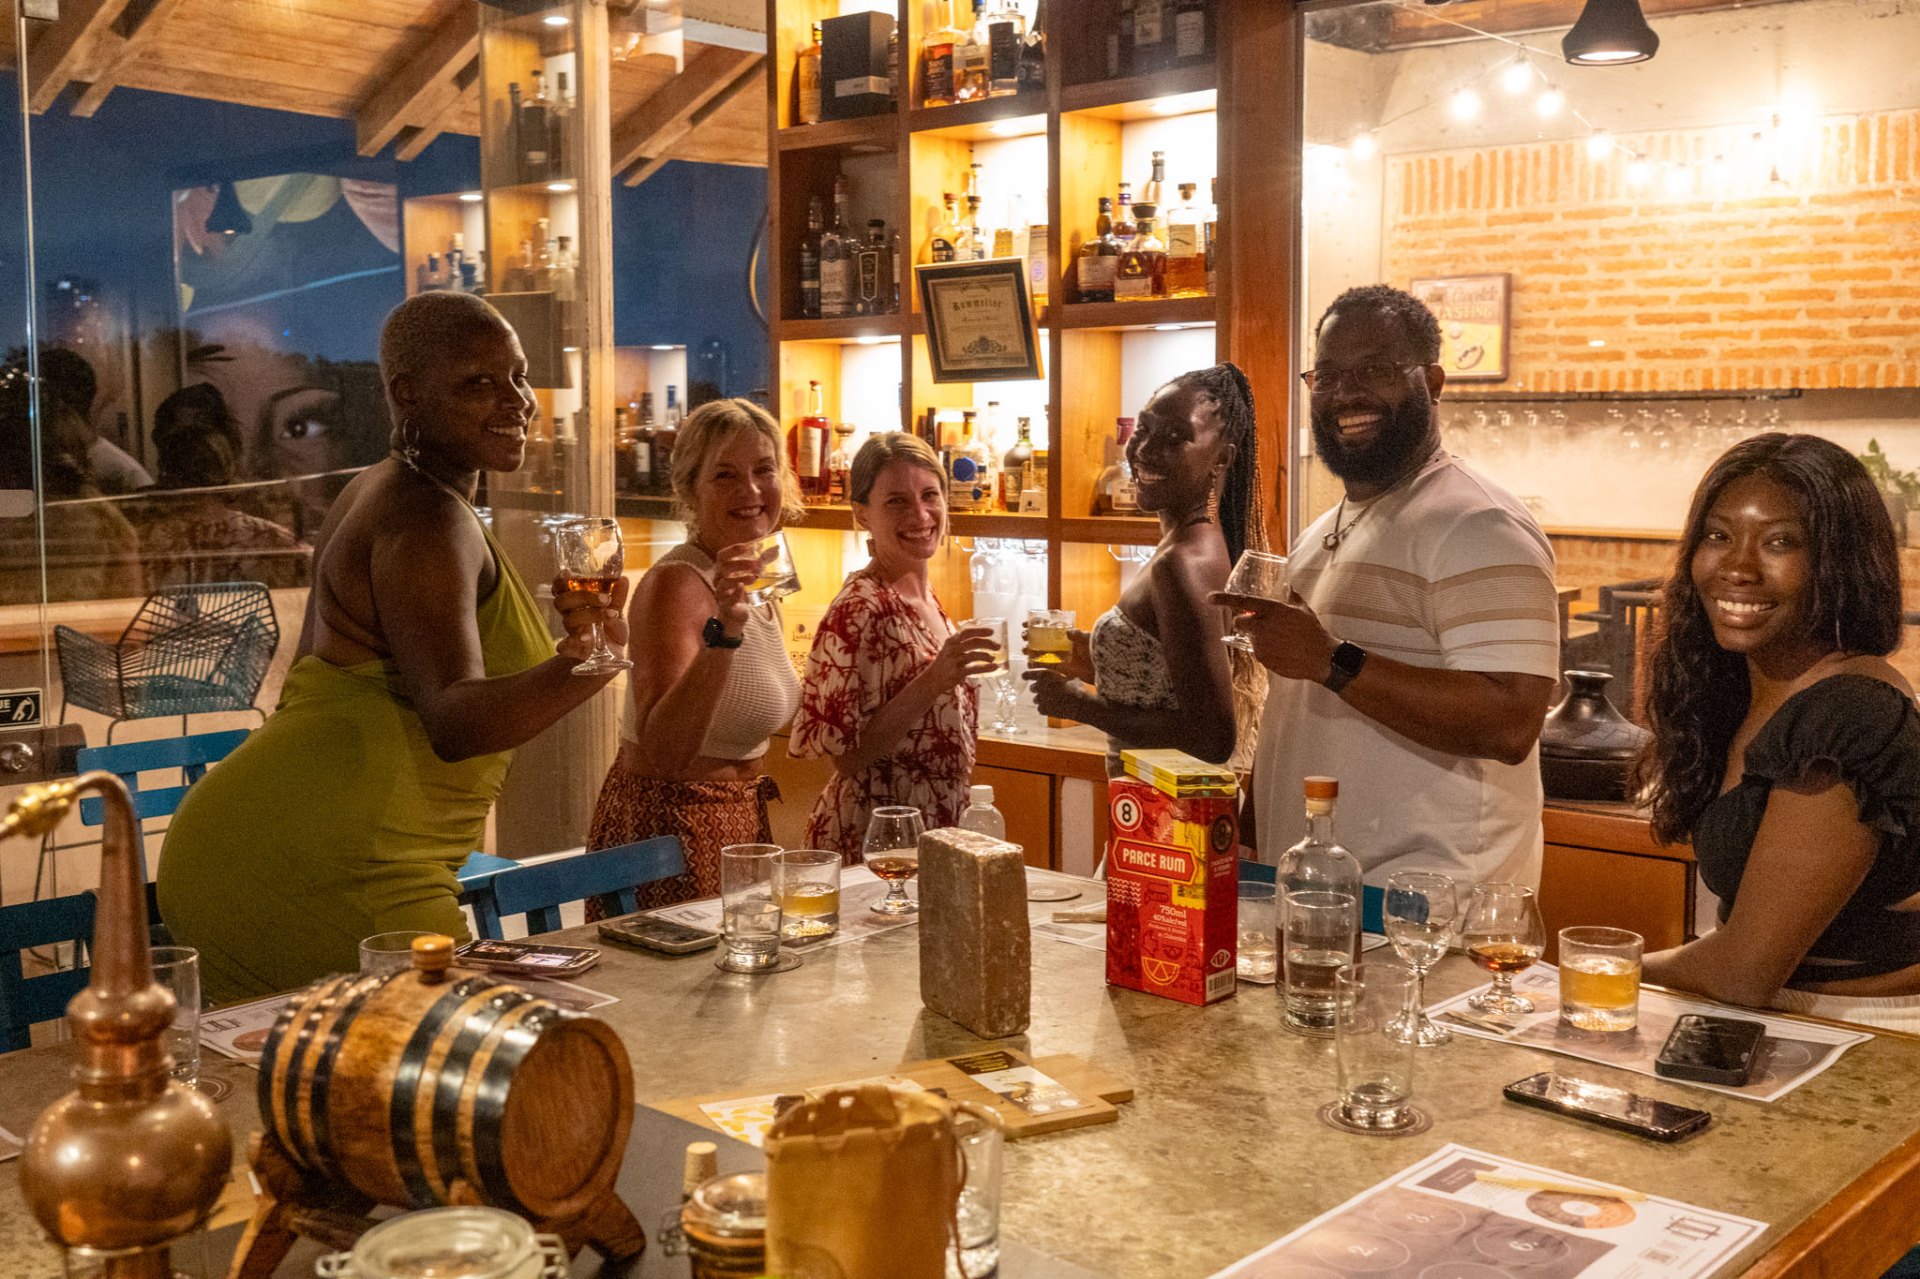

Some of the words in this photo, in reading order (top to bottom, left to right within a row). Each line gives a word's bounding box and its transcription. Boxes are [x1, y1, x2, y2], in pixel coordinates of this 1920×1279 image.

[1121, 802, 1132, 823] 8
[1122, 847, 1157, 868] PARCE
[1159, 854, 1186, 874] RUM
[1160, 904, 1187, 918] 750ml
